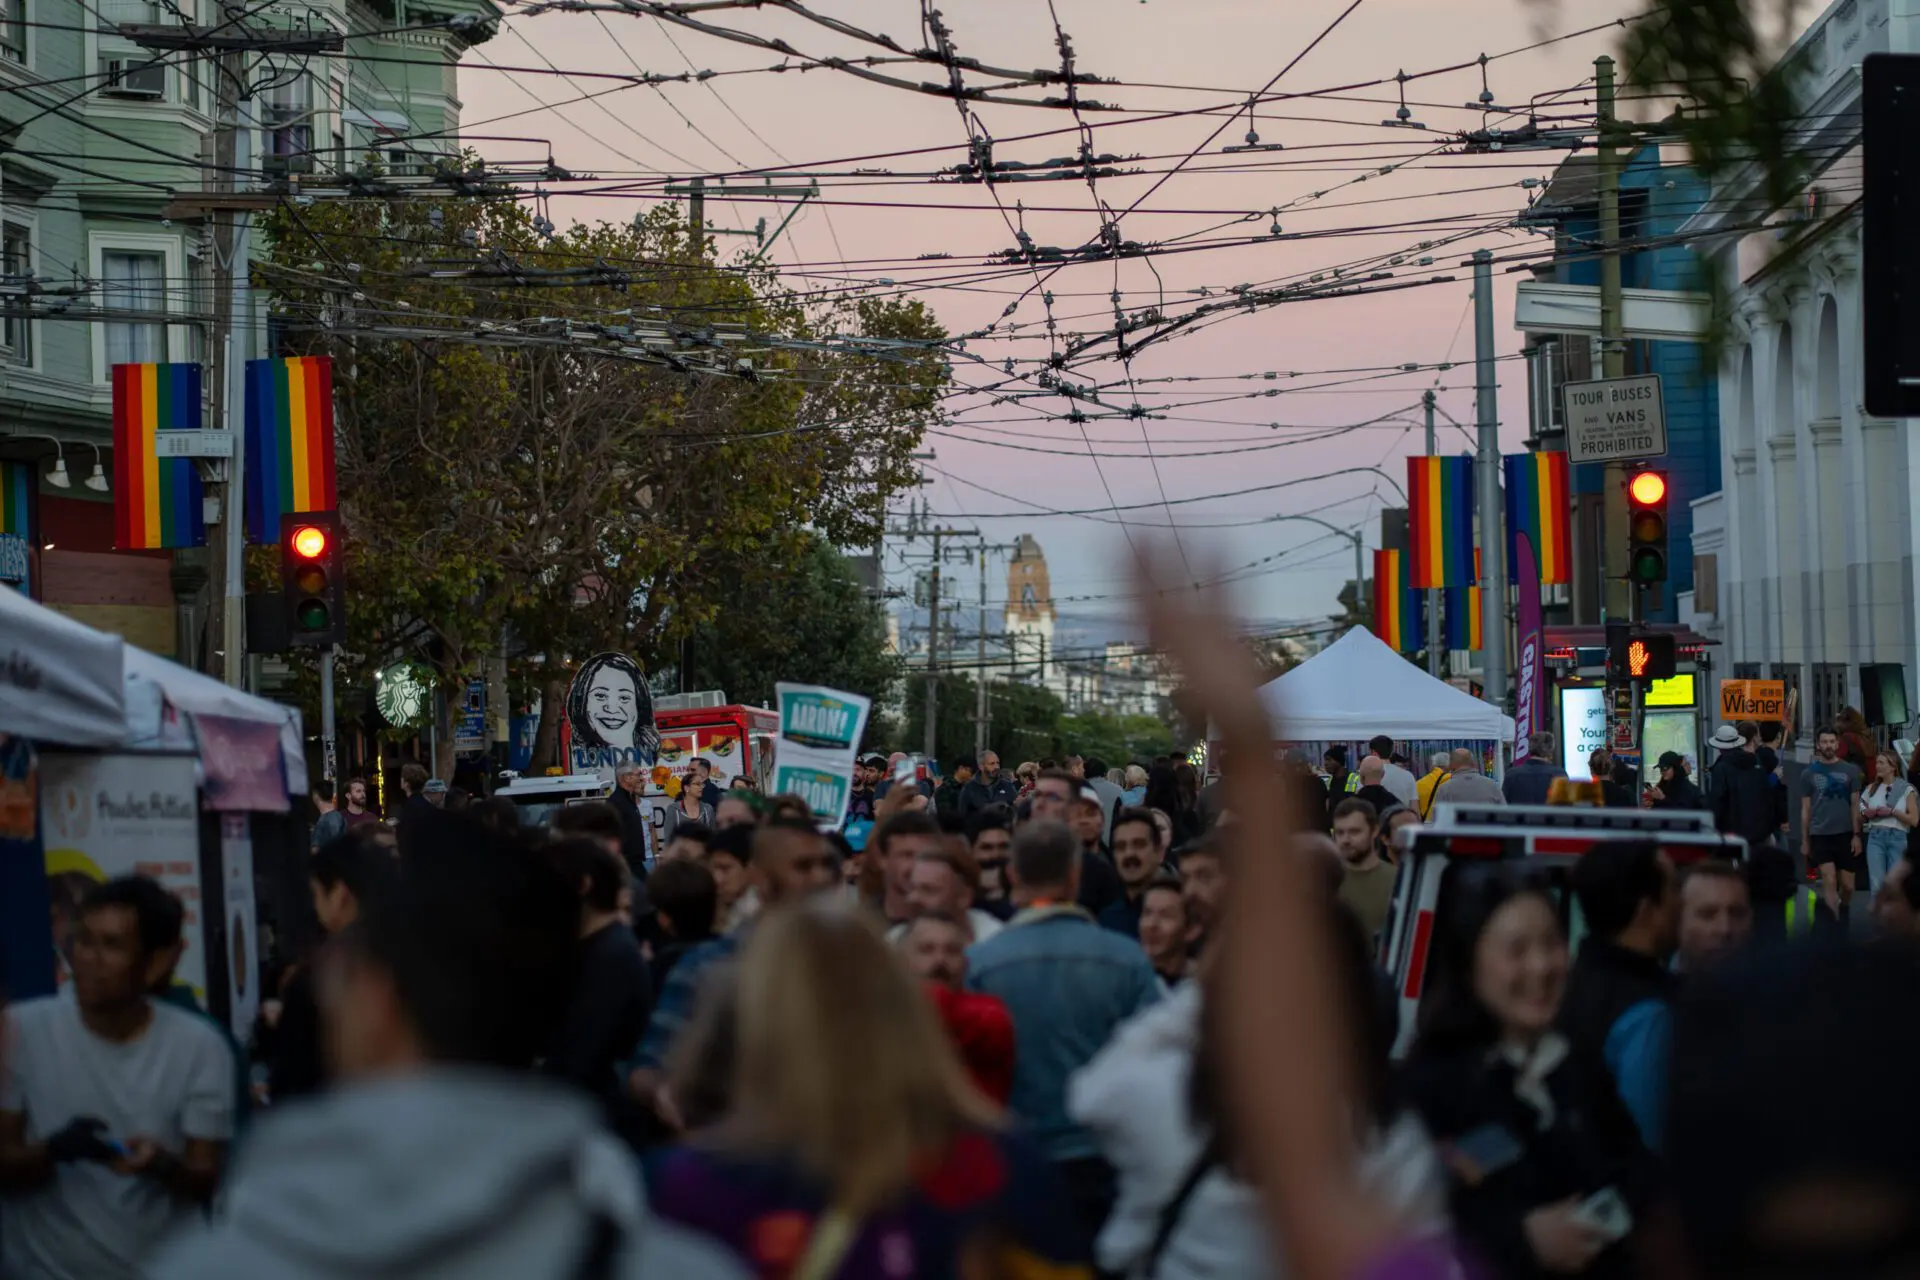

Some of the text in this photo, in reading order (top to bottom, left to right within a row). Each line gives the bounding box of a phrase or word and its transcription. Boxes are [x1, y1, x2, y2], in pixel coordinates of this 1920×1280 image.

[1572, 386, 1652, 406] TOUR BUSES
[1584, 409, 1646, 424] AND VANS
[1581, 436, 1653, 455] PROHIBITED
[1515, 643, 1535, 761] CASTRO
[1723, 694, 1783, 715] Wiener
[790, 702, 849, 739] AARON!
[574, 746, 654, 769] LONDON
[1577, 743, 1585, 752] a
